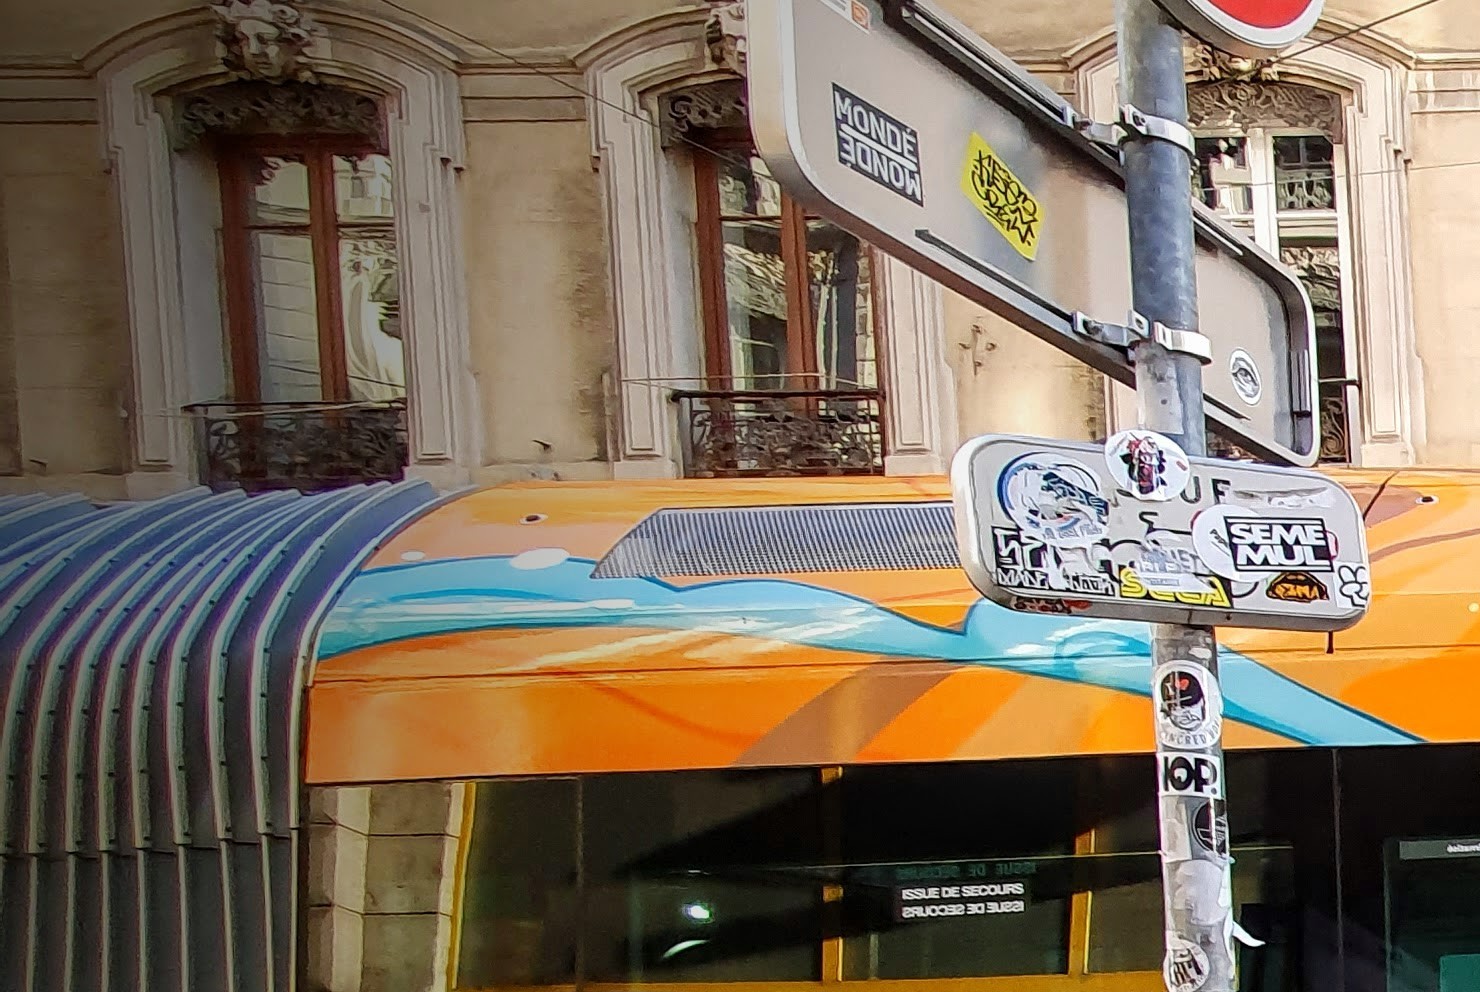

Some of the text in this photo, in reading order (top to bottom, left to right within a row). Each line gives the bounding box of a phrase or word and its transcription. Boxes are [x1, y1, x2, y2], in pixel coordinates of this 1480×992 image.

[834, 90, 918, 161] MONDÉ
[1230, 524, 1327, 546] SEME
[1236, 544, 1331, 567] MUL
[902, 883, 1025, 900] ISSUE DE SECOURS
